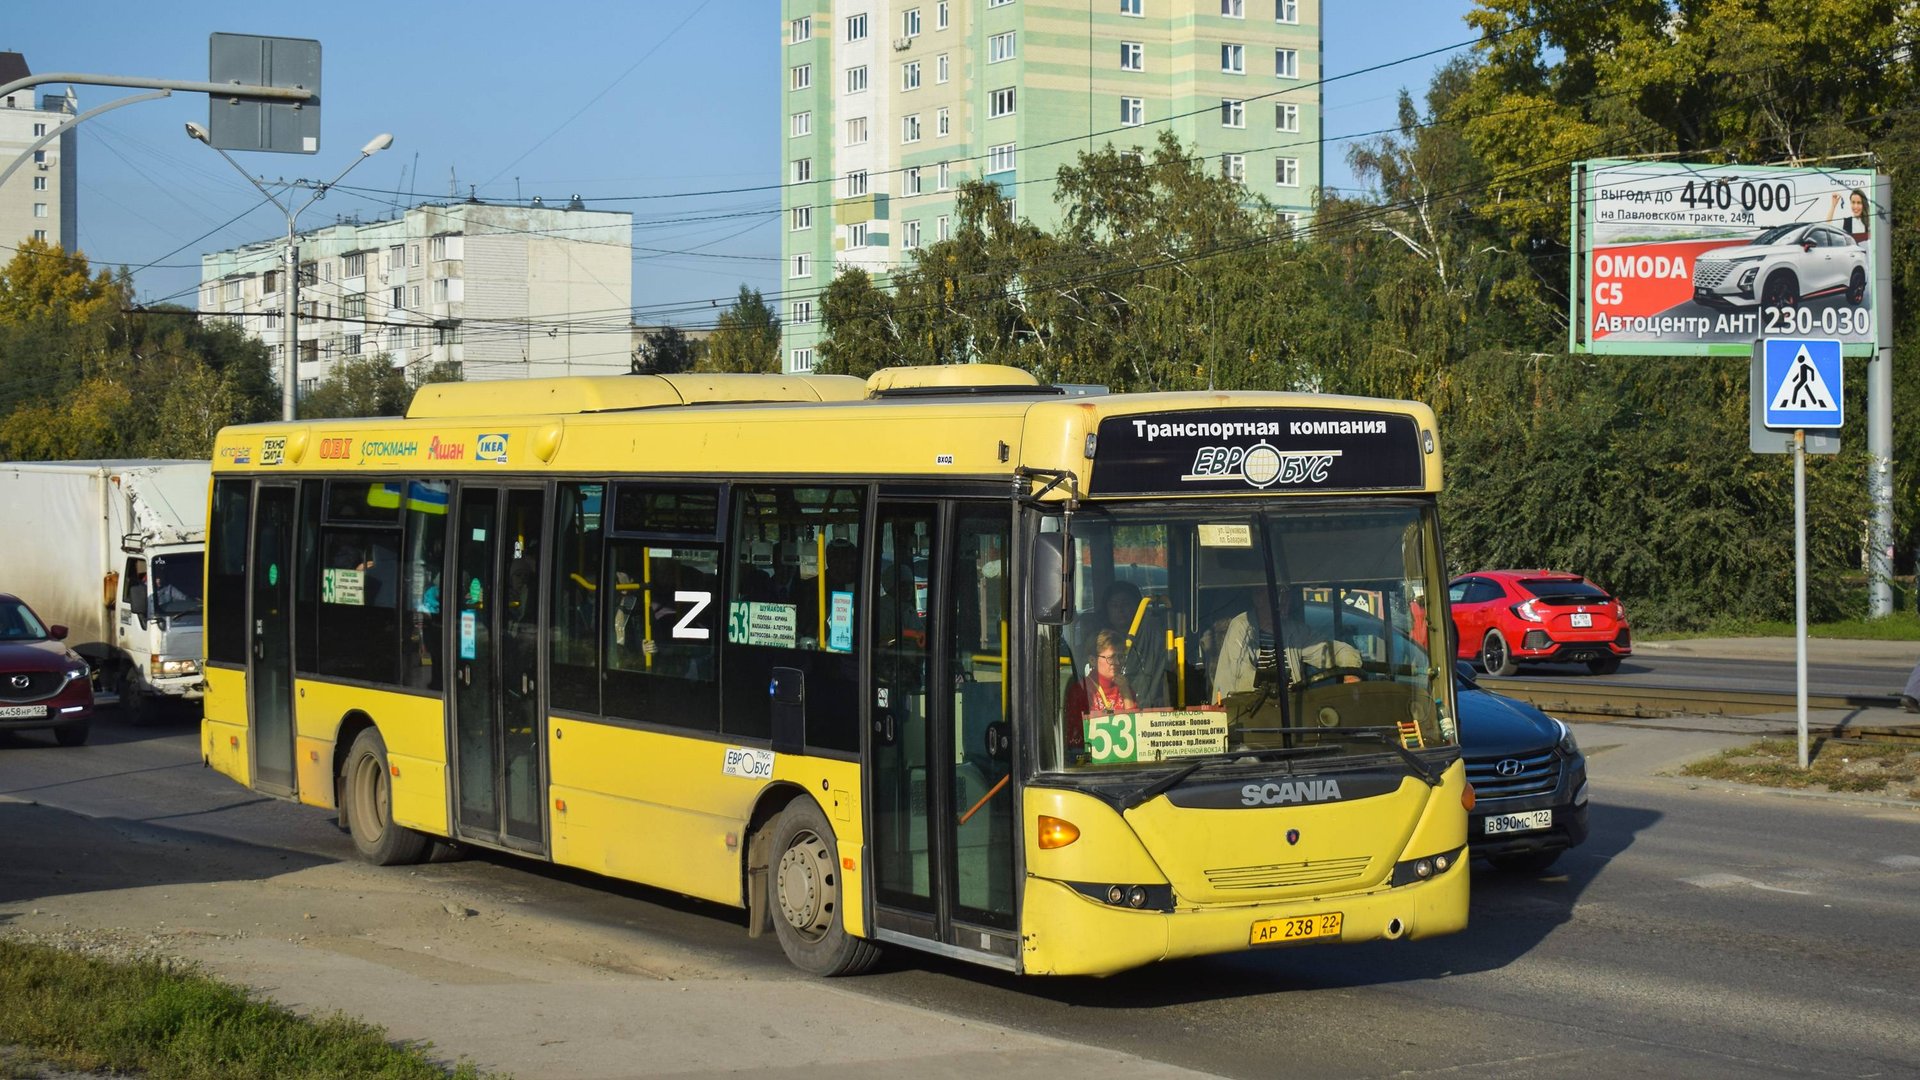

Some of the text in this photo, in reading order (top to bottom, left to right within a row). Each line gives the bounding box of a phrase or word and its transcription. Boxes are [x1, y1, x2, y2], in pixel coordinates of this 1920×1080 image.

[1600, 179, 1791, 212] ВЫГОДА ДО 440 000
[1600, 209, 1755, 226] на Павловском тракте, 249Д
[1594, 254, 1688, 280] OMODA
[1594, 282, 1623, 306] C5
[1594, 311, 1757, 338] Автоцентр АНТ
[1764, 306, 1870, 335] 230-030
[1132, 420, 1387, 441] Транспортная компания
[264, 440, 286, 450] ТЕХНО
[319, 438, 352, 459] OBI
[367, 441, 418, 456] СТОКМАНН
[427, 435, 465, 460] Ашан
[480, 441, 504, 452] IKEA
[936, 456, 953, 464] ВХОД
[672, 590, 712, 640] Z
[728, 601, 749, 644] 53
[1141, 730, 1163, 738] Юрина
[1172, 729, 1196, 737] Петрова
[1150, 718, 1211, 728] Балтийская Попова
[1087, 713, 1136, 760] 53
[1150, 739, 1183, 748] Матросова
[1240, 779, 1342, 806] SCANIA
[1488, 811, 1549, 832] В890МС 122
[1259, 915, 1337, 940] АР 238 22
